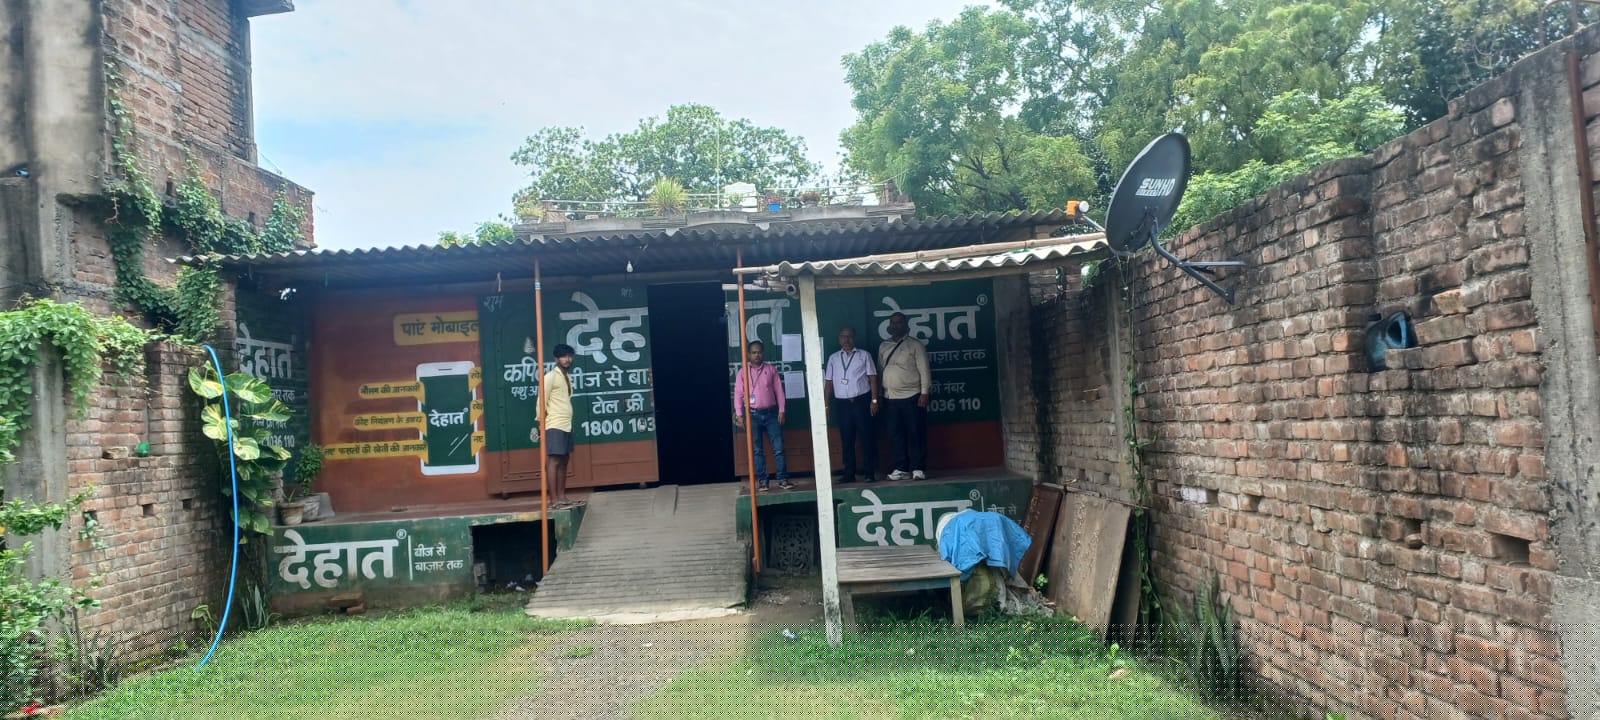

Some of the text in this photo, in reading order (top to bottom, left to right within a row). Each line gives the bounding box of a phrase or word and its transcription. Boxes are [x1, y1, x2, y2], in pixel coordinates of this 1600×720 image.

[961, 349, 986, 361] तक
[504, 356, 557, 382] कपिल
[604, 365, 624, 386] से
[592, 393, 645, 414] टोल फ्री
[959, 398, 981, 411] 110
[427, 409, 465, 427] देहात
[581, 416, 655, 436] 1800 103
[273, 529, 399, 589] देहात
[413, 543, 434, 557] बीज
[447, 560, 464, 570] तक
